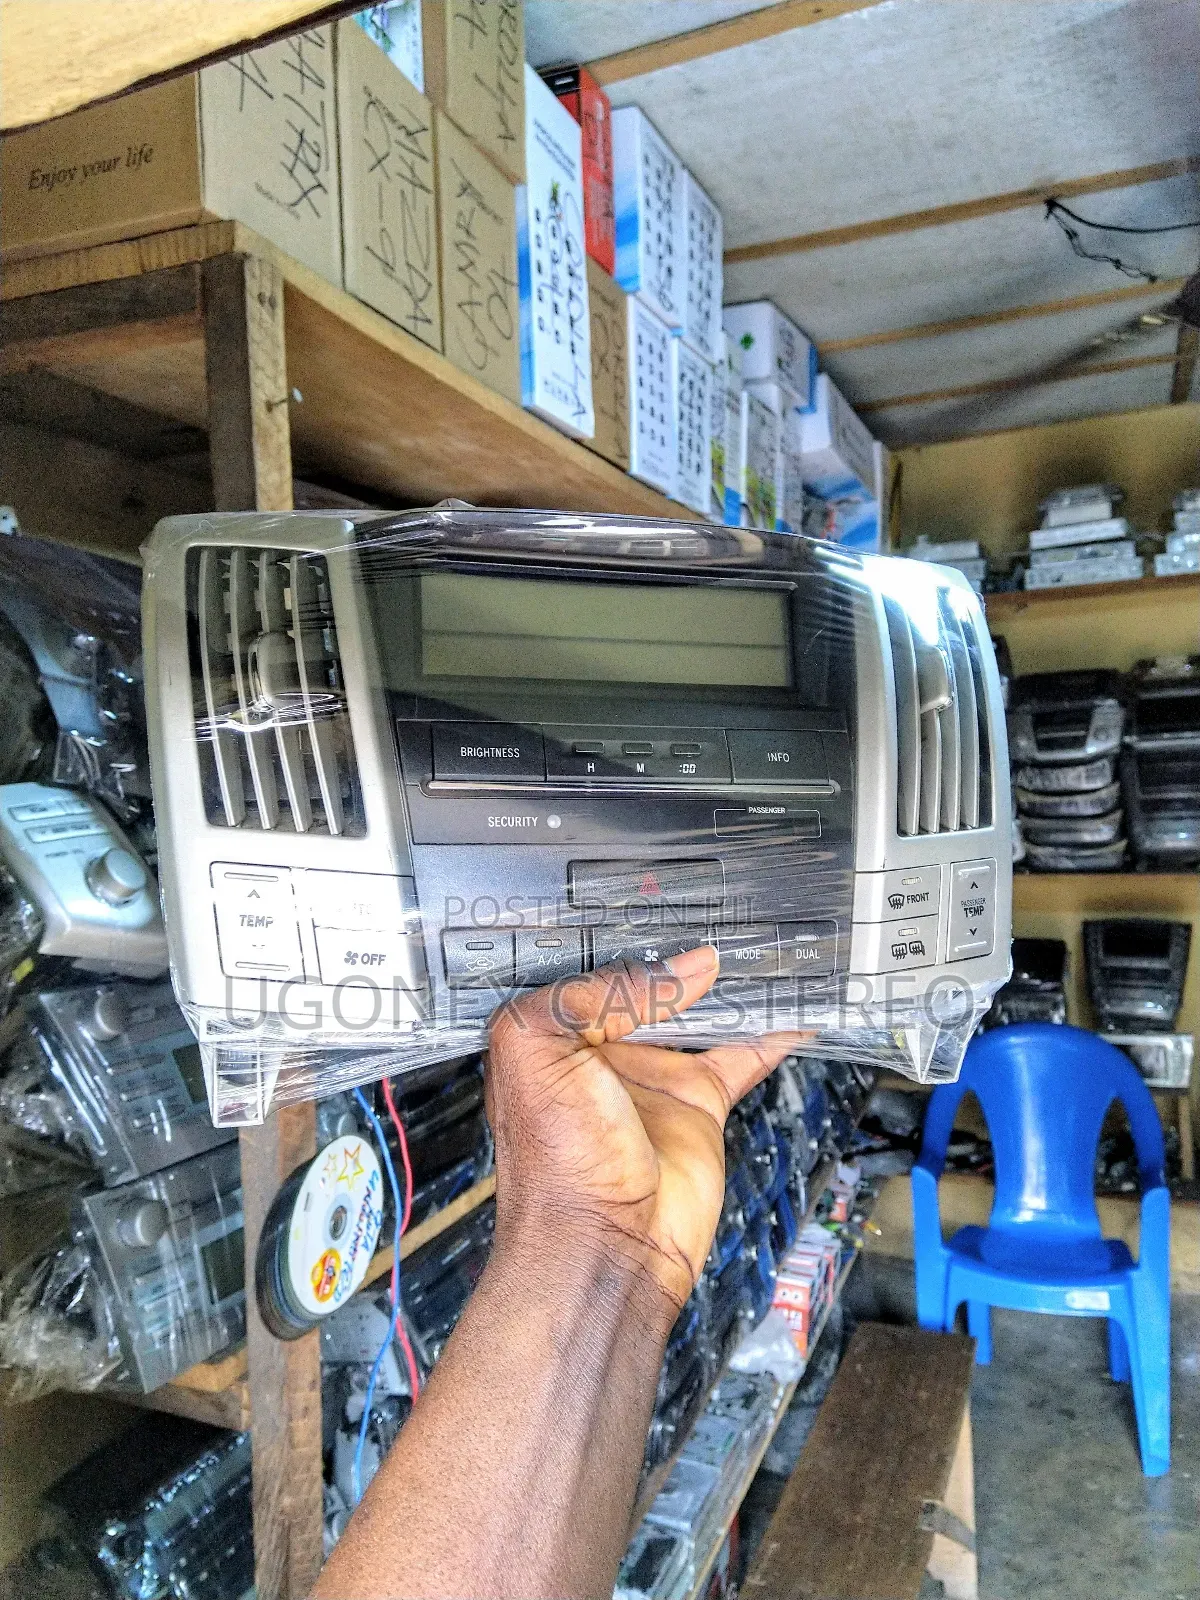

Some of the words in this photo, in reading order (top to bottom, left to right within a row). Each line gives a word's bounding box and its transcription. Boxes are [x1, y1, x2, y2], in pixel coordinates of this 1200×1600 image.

[28, 165, 79, 192] Enjoy
[80, 156, 121, 184] your
[124, 142, 154, 171] life
[396, 102, 434, 334] MAZDA
[450, 158, 501, 371] CAMRY
[460, 746, 520, 758] BRIGHTNESS
[767, 752, 790, 763] INFO
[587, 762, 594, 773] H
[636, 763, 645, 773] M
[748, 806, 786, 814] PASSENGER
[487, 815, 539, 828] SECURITY
[906, 892, 930, 904] FRONT
[960, 897, 986, 908] PASSENGER
[963, 905, 985, 918] TEMP
[238, 913, 274, 929] TEMP
[360, 952, 387, 966] OFF
[537, 953, 562, 966] A/C
[735, 948, 761, 961] MODE
[795, 948, 820, 960] DUAL
